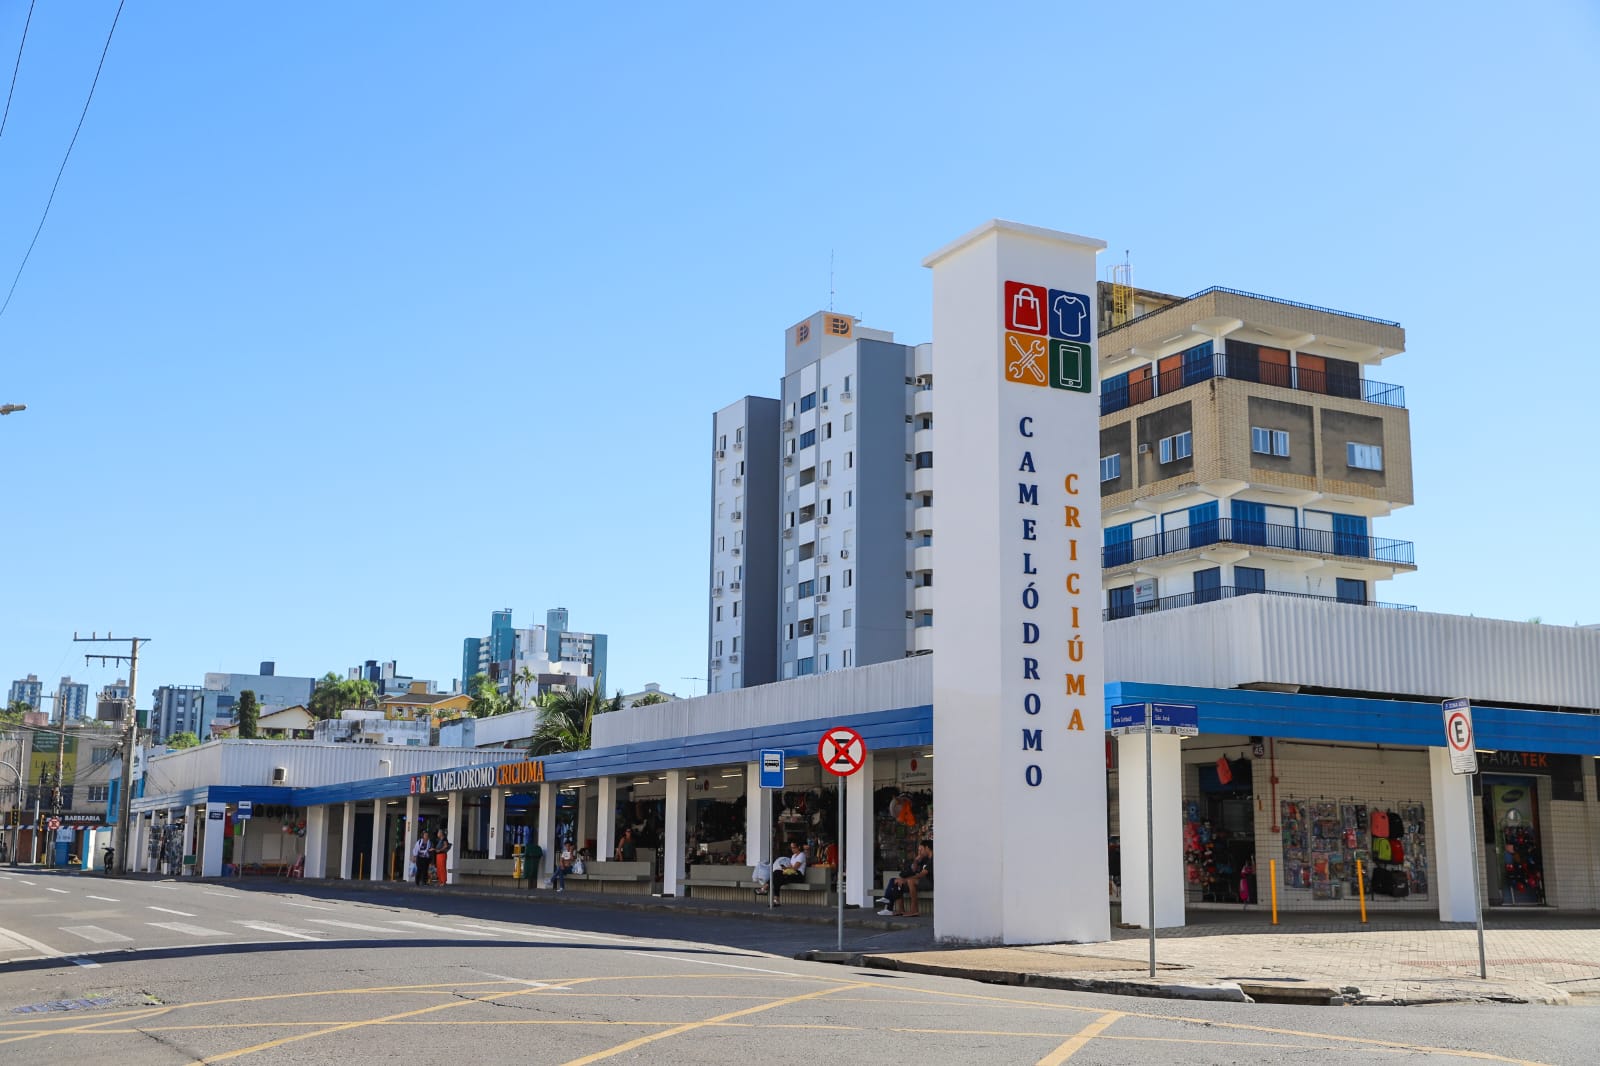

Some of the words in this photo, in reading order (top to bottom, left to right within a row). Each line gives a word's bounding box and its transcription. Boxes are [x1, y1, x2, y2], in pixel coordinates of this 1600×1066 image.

[1018, 416, 1042, 787] CAMELÓDROMO
[1064, 473, 1086, 731] CRICIÚMA
[496, 754, 544, 784] CRICIÚMA
[1454, 721, 1464, 742] E
